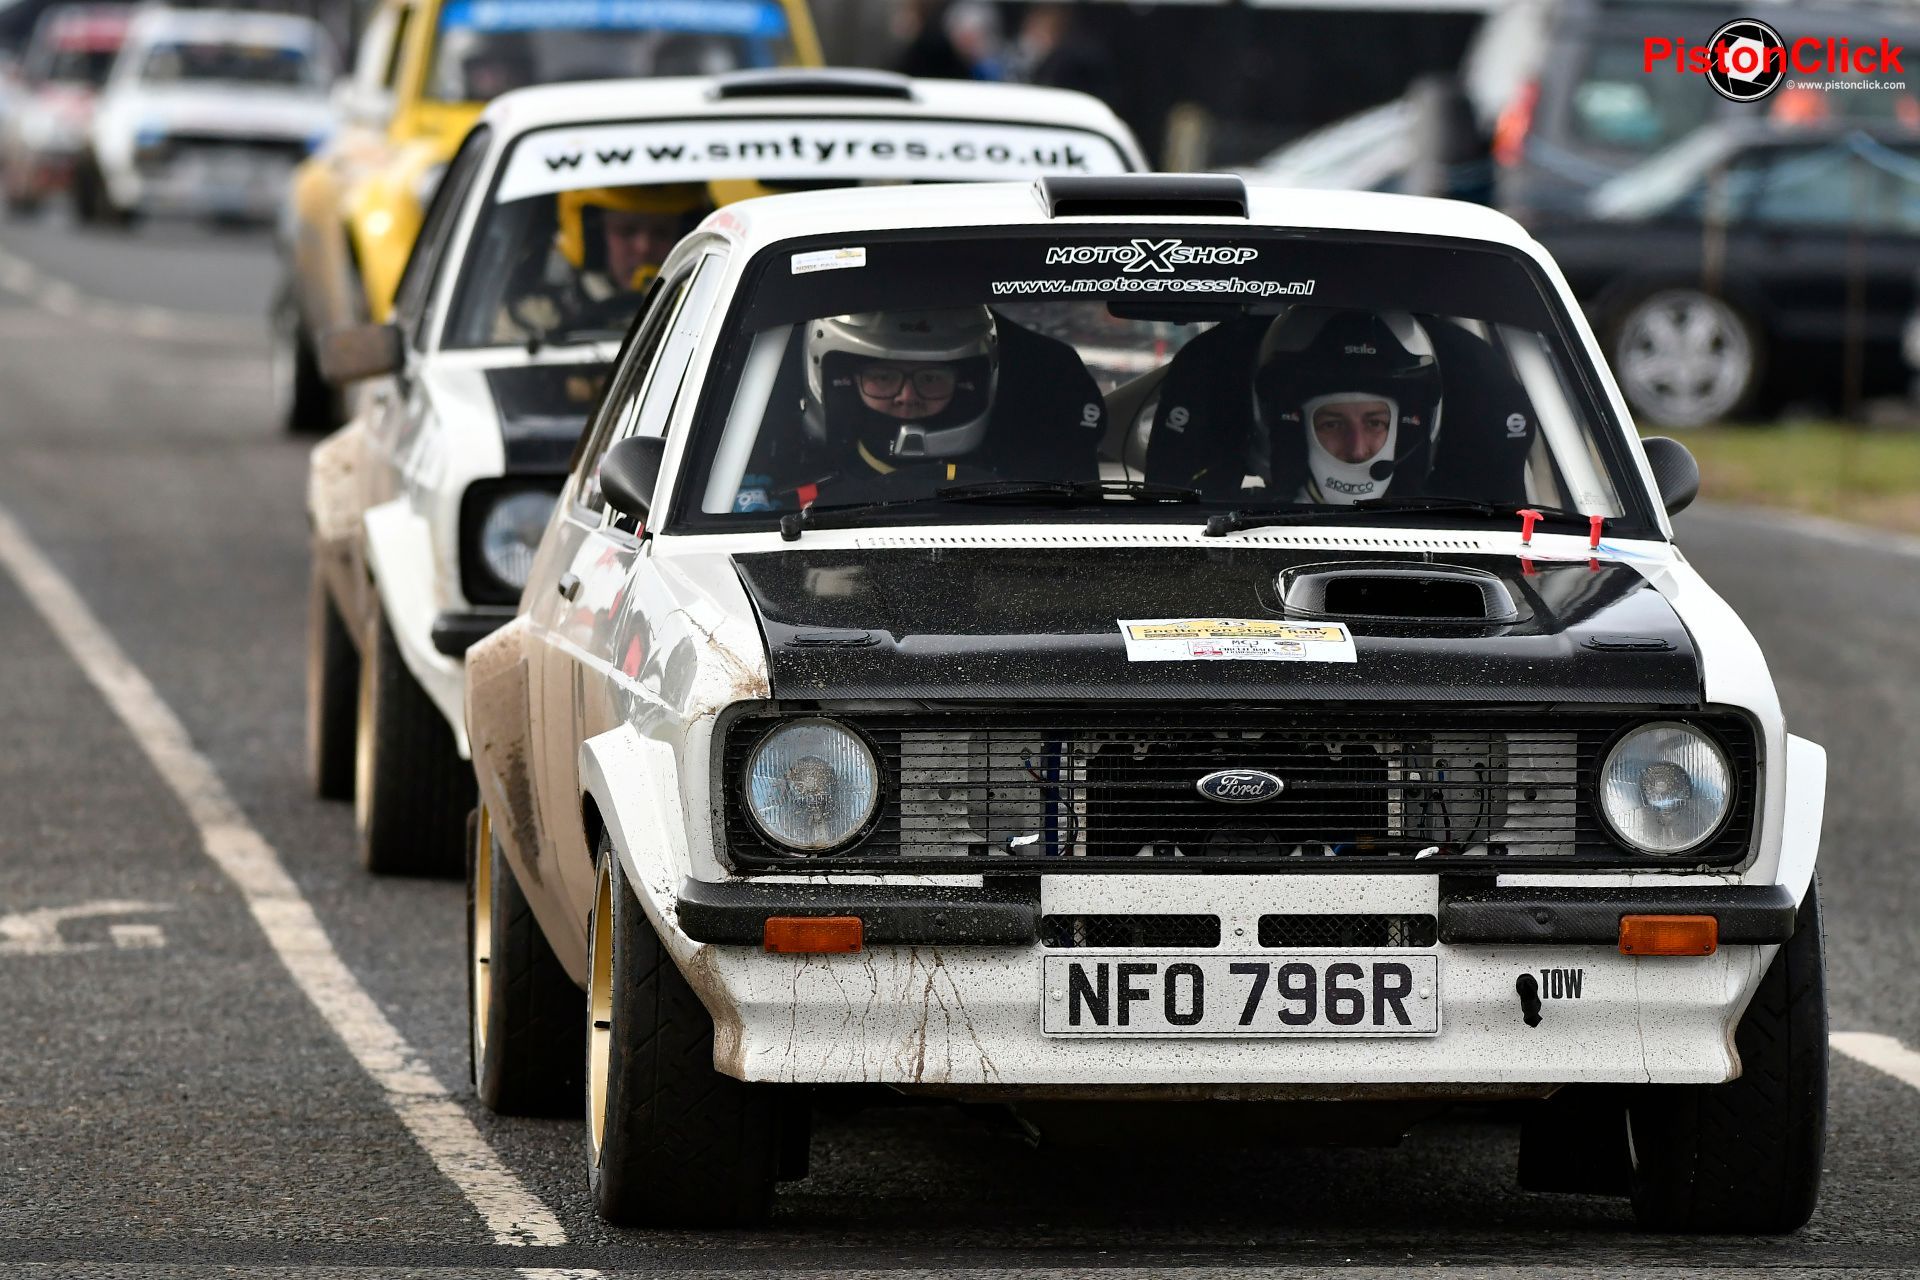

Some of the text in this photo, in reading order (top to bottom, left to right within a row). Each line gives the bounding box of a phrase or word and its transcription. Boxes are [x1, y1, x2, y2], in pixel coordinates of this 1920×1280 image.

[544, 135, 1091, 173] www.smtyres.co.uk
[991, 277, 1316, 296] www.motocrossshop.nl
[1344, 343, 1377, 355] stilo
[1324, 477, 1374, 495] sparco
[1216, 775, 1265, 796] Ford
[1068, 962, 1413, 1026] NFO 796R
[1540, 968, 1583, 1000] TOW
